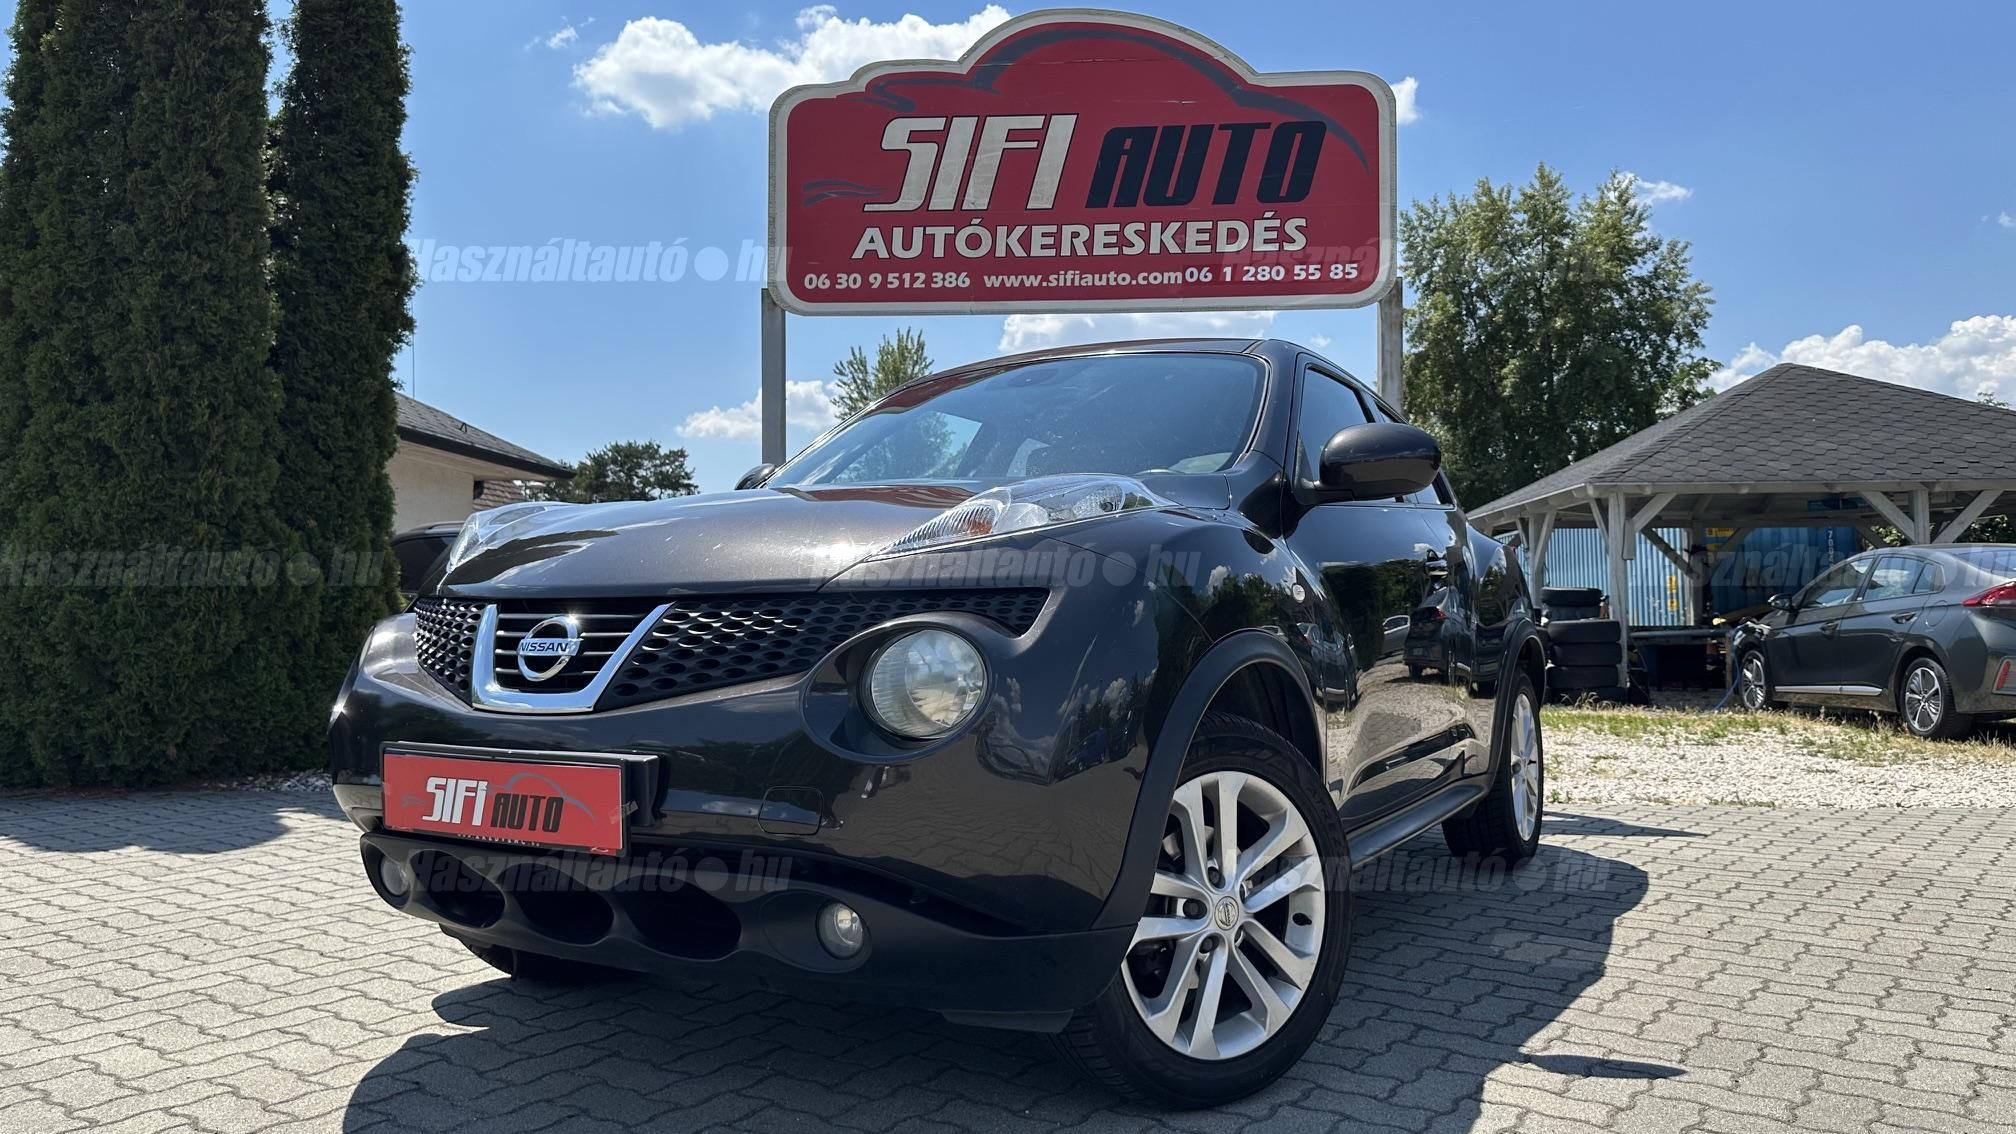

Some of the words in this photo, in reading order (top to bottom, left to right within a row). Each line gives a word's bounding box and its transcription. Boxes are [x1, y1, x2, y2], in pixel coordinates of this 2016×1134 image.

[863, 113, 1078, 212] SIFI
[1085, 120, 1327, 209] AUTO
[850, 211, 1309, 260] AUTÓKERESKEDÉS
[804, 273, 831, 289] 06
[835, 273, 862, 289] 30
[868, 273, 882, 289] 9
[887, 272, 926, 289] 512
[931, 271, 971, 288] 386
[983, 269, 1183, 288] www.sifiauto.com
[1184, 266, 1213, 283] 06
[1223, 266, 1233, 282] 1
[1242, 265, 1286, 281] 280
[1293, 264, 1323, 280] 55
[1329, 263, 1359, 280] 85
[520, 642, 569, 653] NISSAN
[422, 776, 489, 827] SIFI
[490, 792, 564, 833] AUTO
